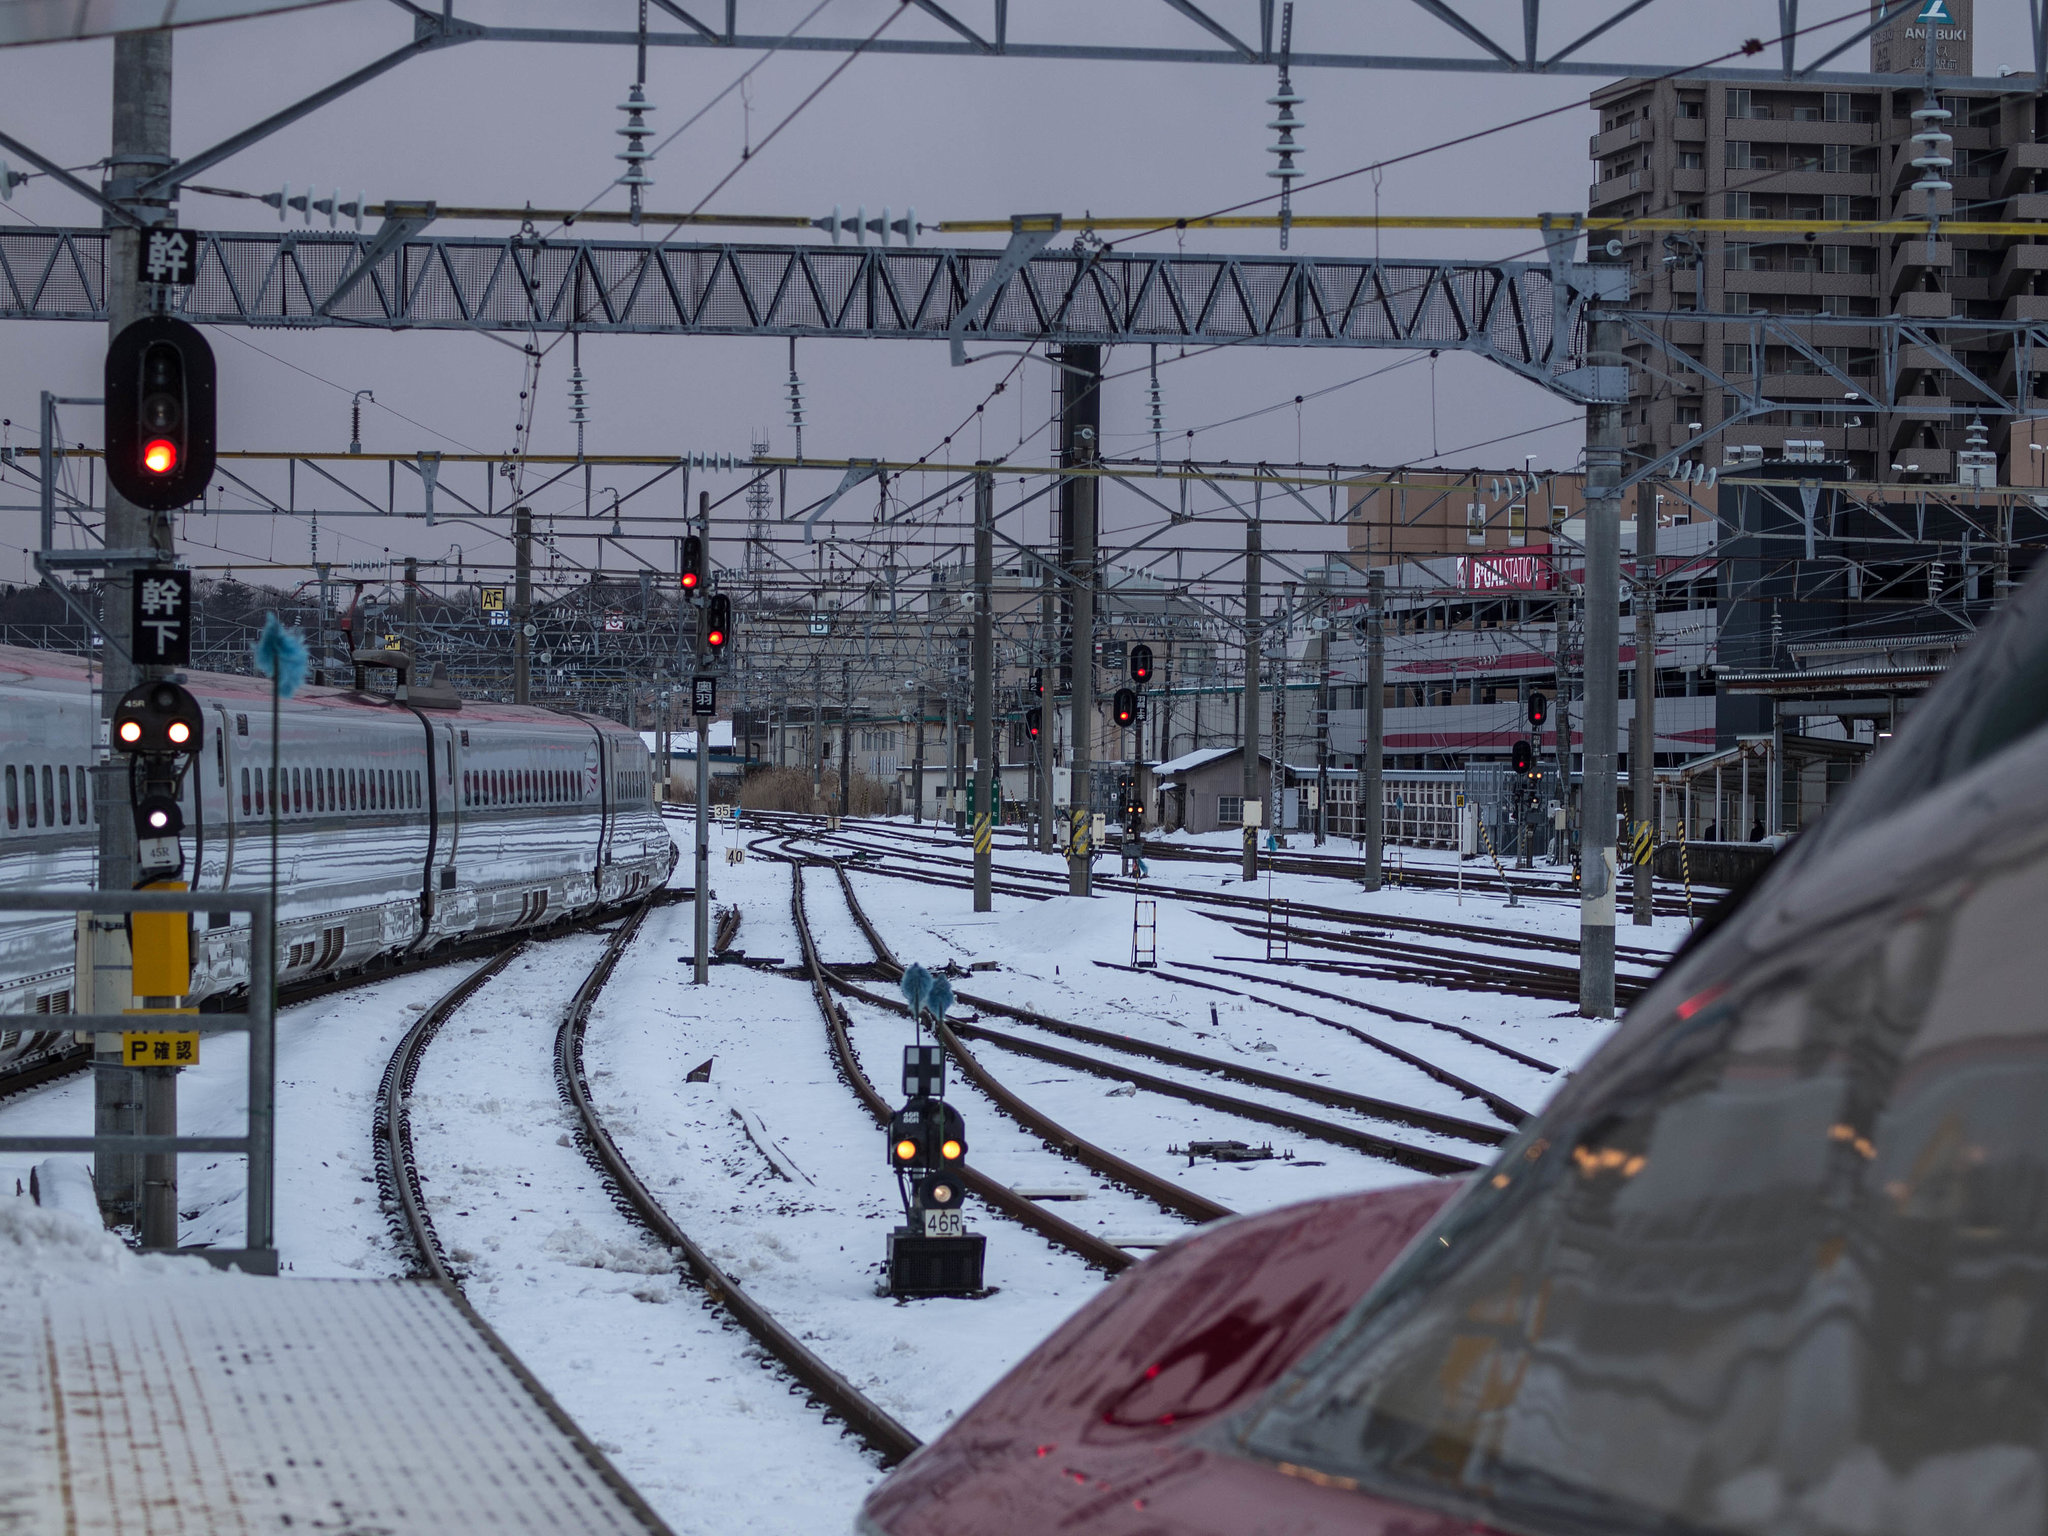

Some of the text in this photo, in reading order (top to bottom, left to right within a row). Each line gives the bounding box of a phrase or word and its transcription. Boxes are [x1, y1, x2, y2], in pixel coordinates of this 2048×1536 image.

[1905, 28, 1966, 40] ANBUKI
[147, 231, 188, 281] 幹
[484, 592, 501, 607] AF
[141, 578, 182, 655] 幹下
[716, 806, 729, 816] 35
[151, 847, 169, 858] 45R
[728, 850, 743, 862] 40
[927, 1214, 960, 1232] 46R
